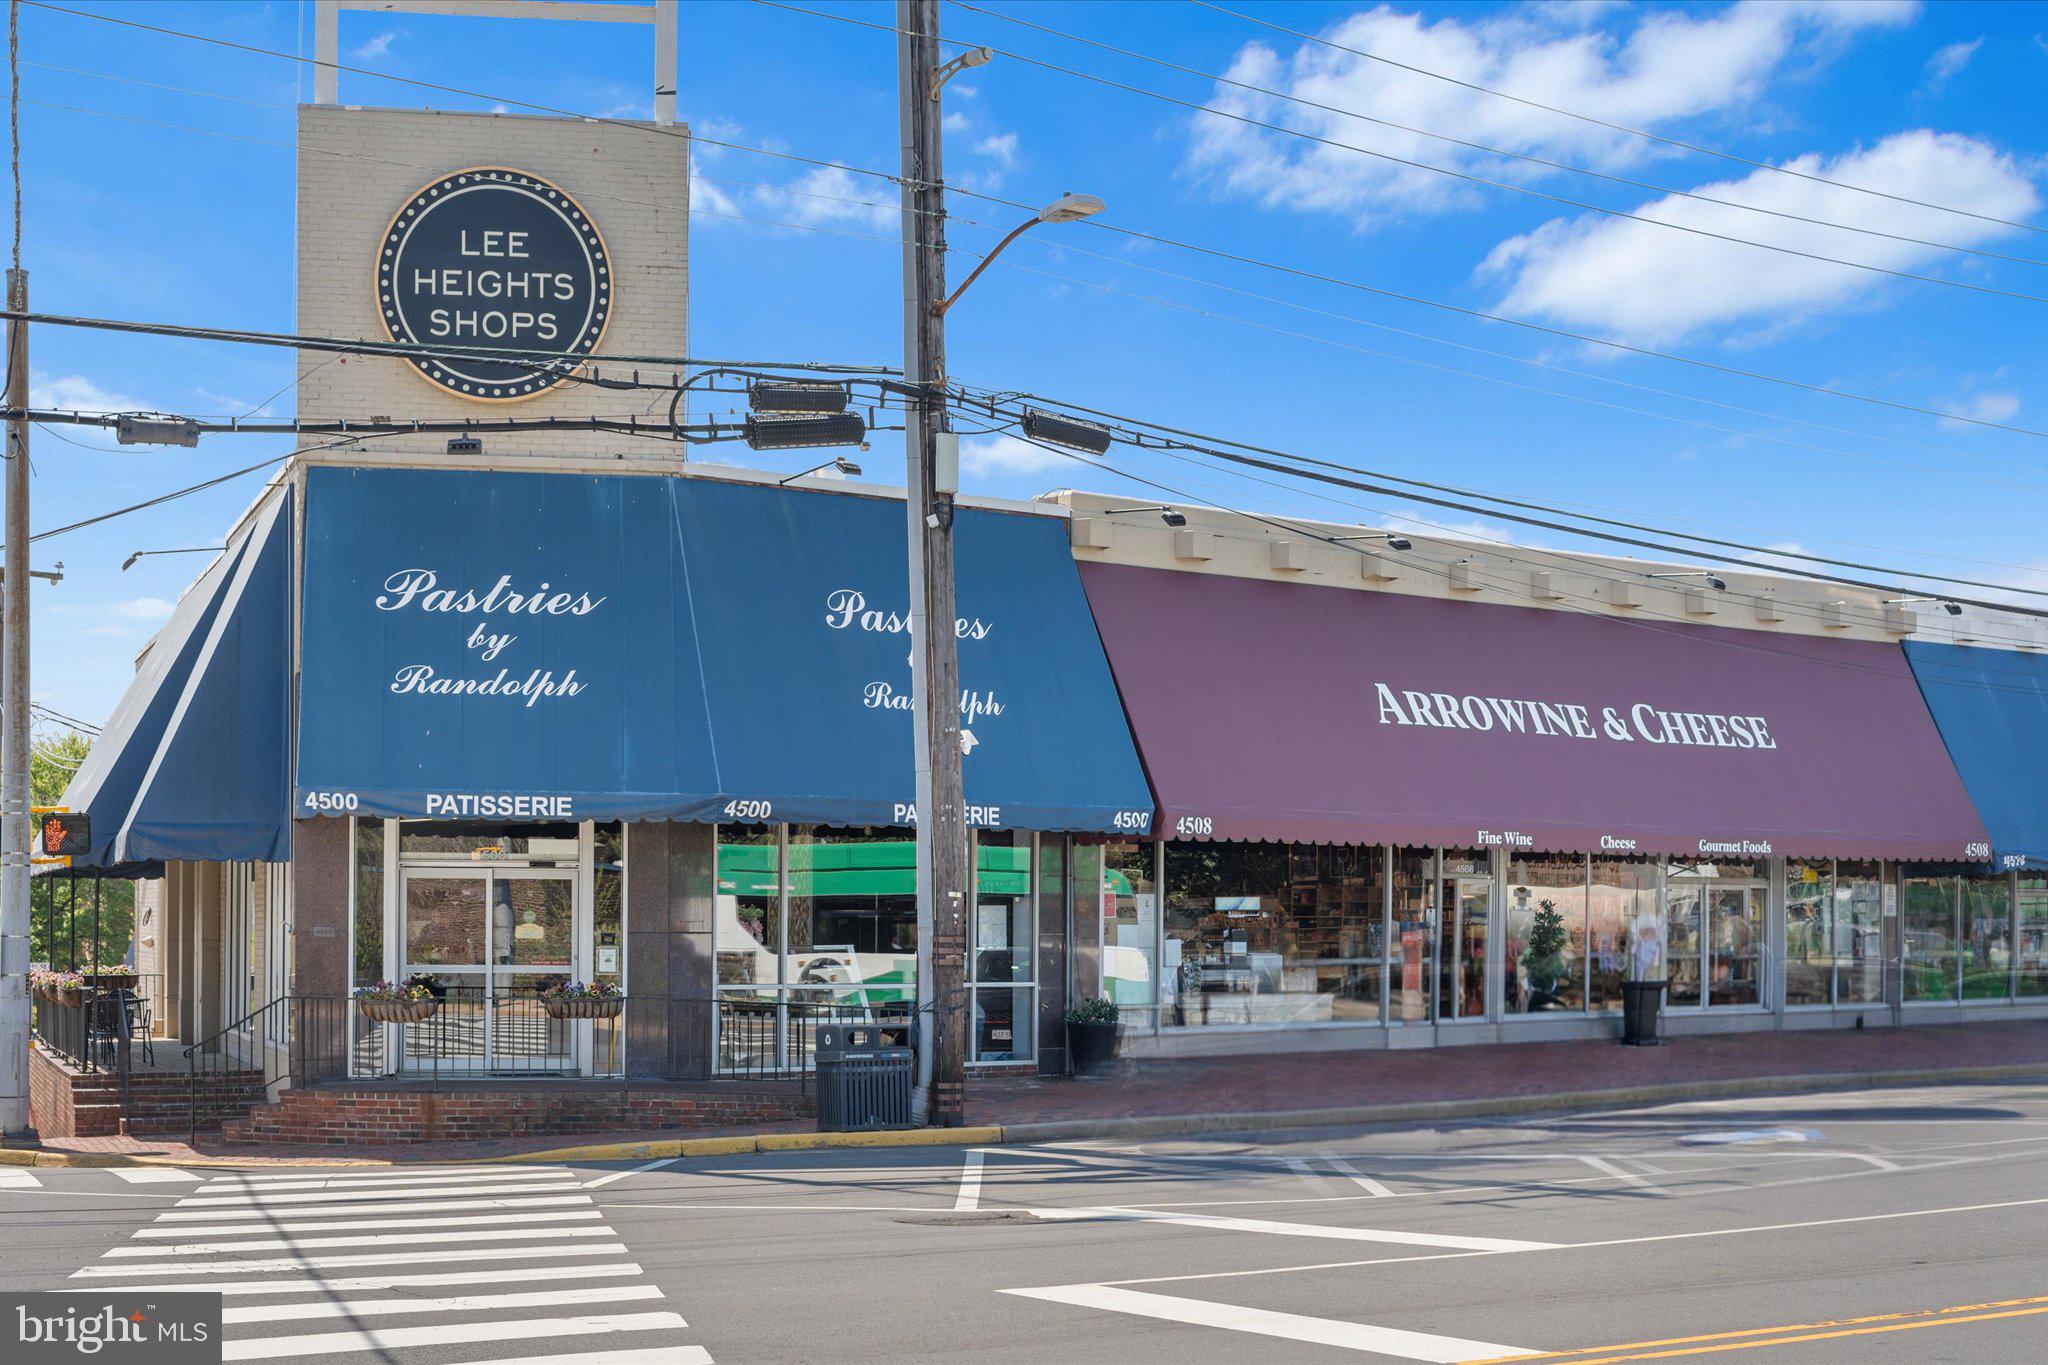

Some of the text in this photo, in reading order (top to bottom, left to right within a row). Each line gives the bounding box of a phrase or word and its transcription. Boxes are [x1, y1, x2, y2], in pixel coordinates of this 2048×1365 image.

[461, 230, 529, 258] LEE
[414, 269, 575, 300] HEIGHTS
[429, 309, 558, 340] SHOPS
[375, 568, 607, 616] Pastries
[466, 622, 518, 662] by
[390, 664, 589, 707] Randolph
[1602, 706, 1634, 742] &
[304, 791, 359, 811] 4500
[426, 794, 573, 817] PATISSERIE
[723, 799, 772, 819] 4500
[894, 803, 1000, 826] PAERIE
[1113, 811, 1150, 829] 4500
[1176, 816, 1213, 835] 4508
[1477, 830, 1533, 847] Fine Wine
[1600, 833, 1636, 850] Cheese
[1698, 838, 1772, 854] Gourmet Foods
[1964, 842, 1989, 857] 4508
[1455, 864, 1475, 874] 4508
